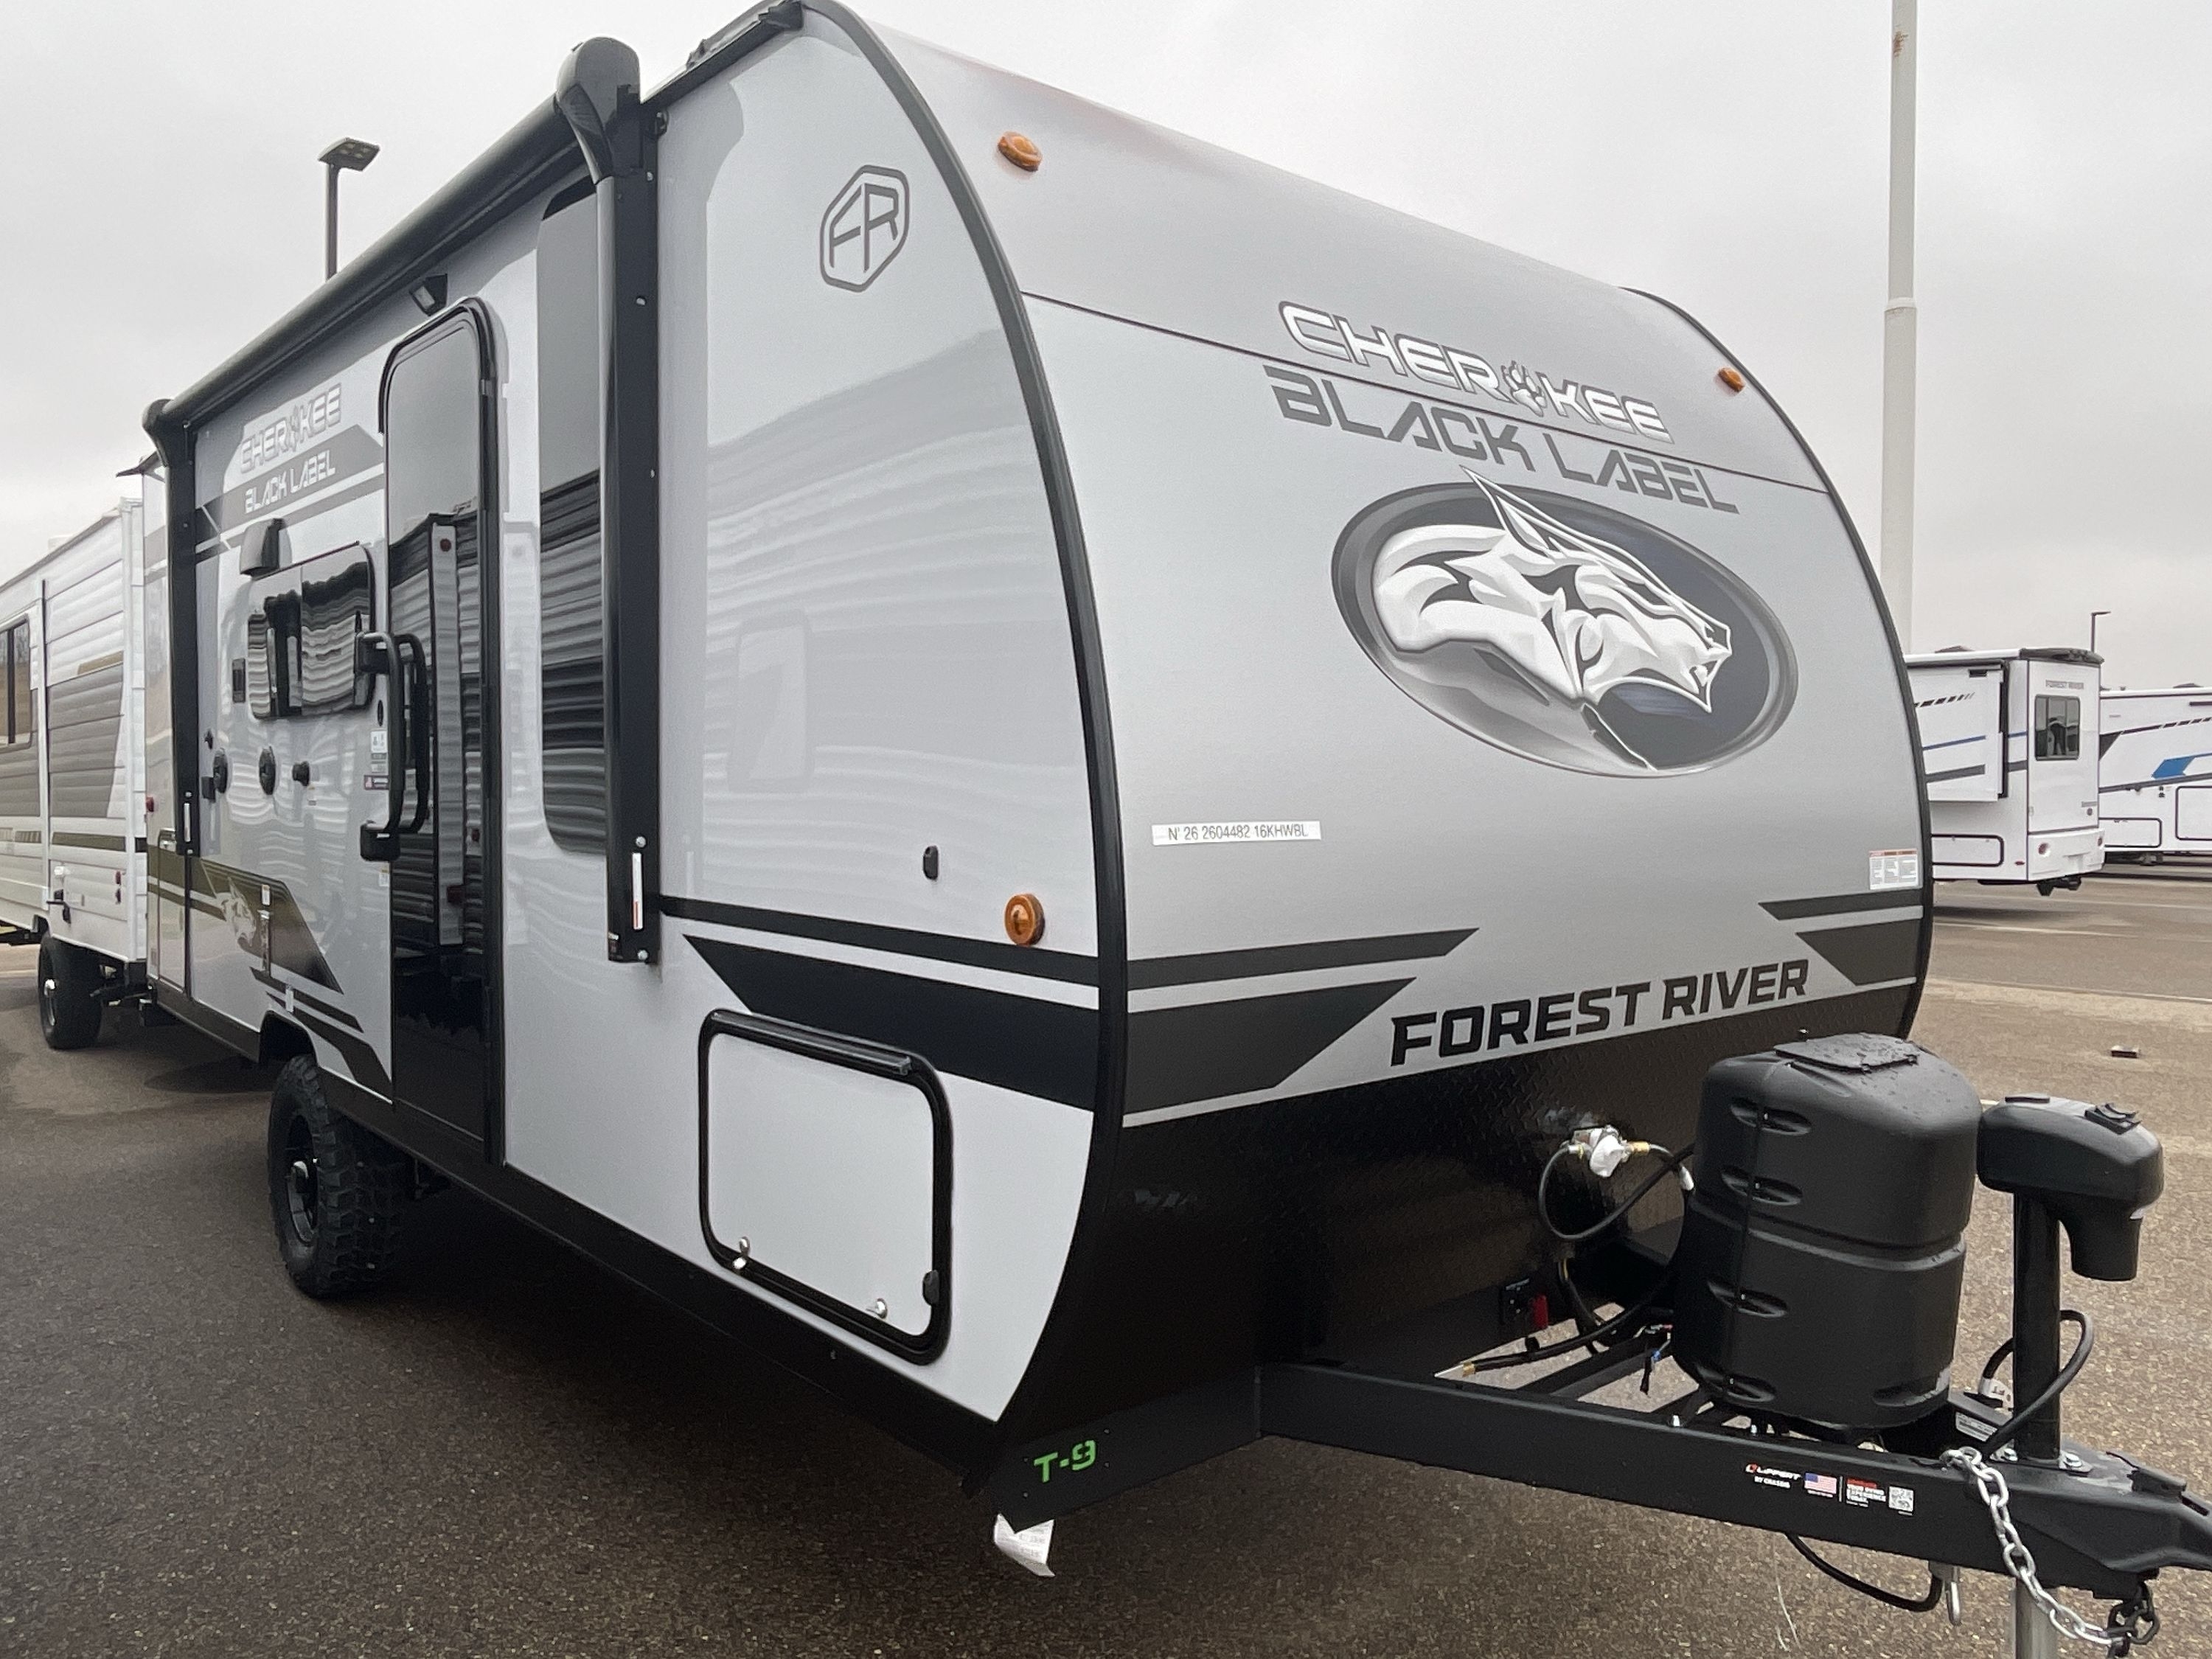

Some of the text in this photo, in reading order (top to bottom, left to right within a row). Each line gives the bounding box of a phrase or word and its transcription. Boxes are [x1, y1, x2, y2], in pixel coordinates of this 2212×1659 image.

[1278, 300, 1675, 444] CHEROKEE
[245, 449, 336, 515] BLACK LABEL
[1262, 364, 1740, 515] BLACK LABEL
[1183, 826, 1199, 841] 26
[1202, 824, 1251, 840] 2604482
[1390, 959, 1810, 1068] FOREST RIVER
[1034, 1439, 1097, 1483] T-9
